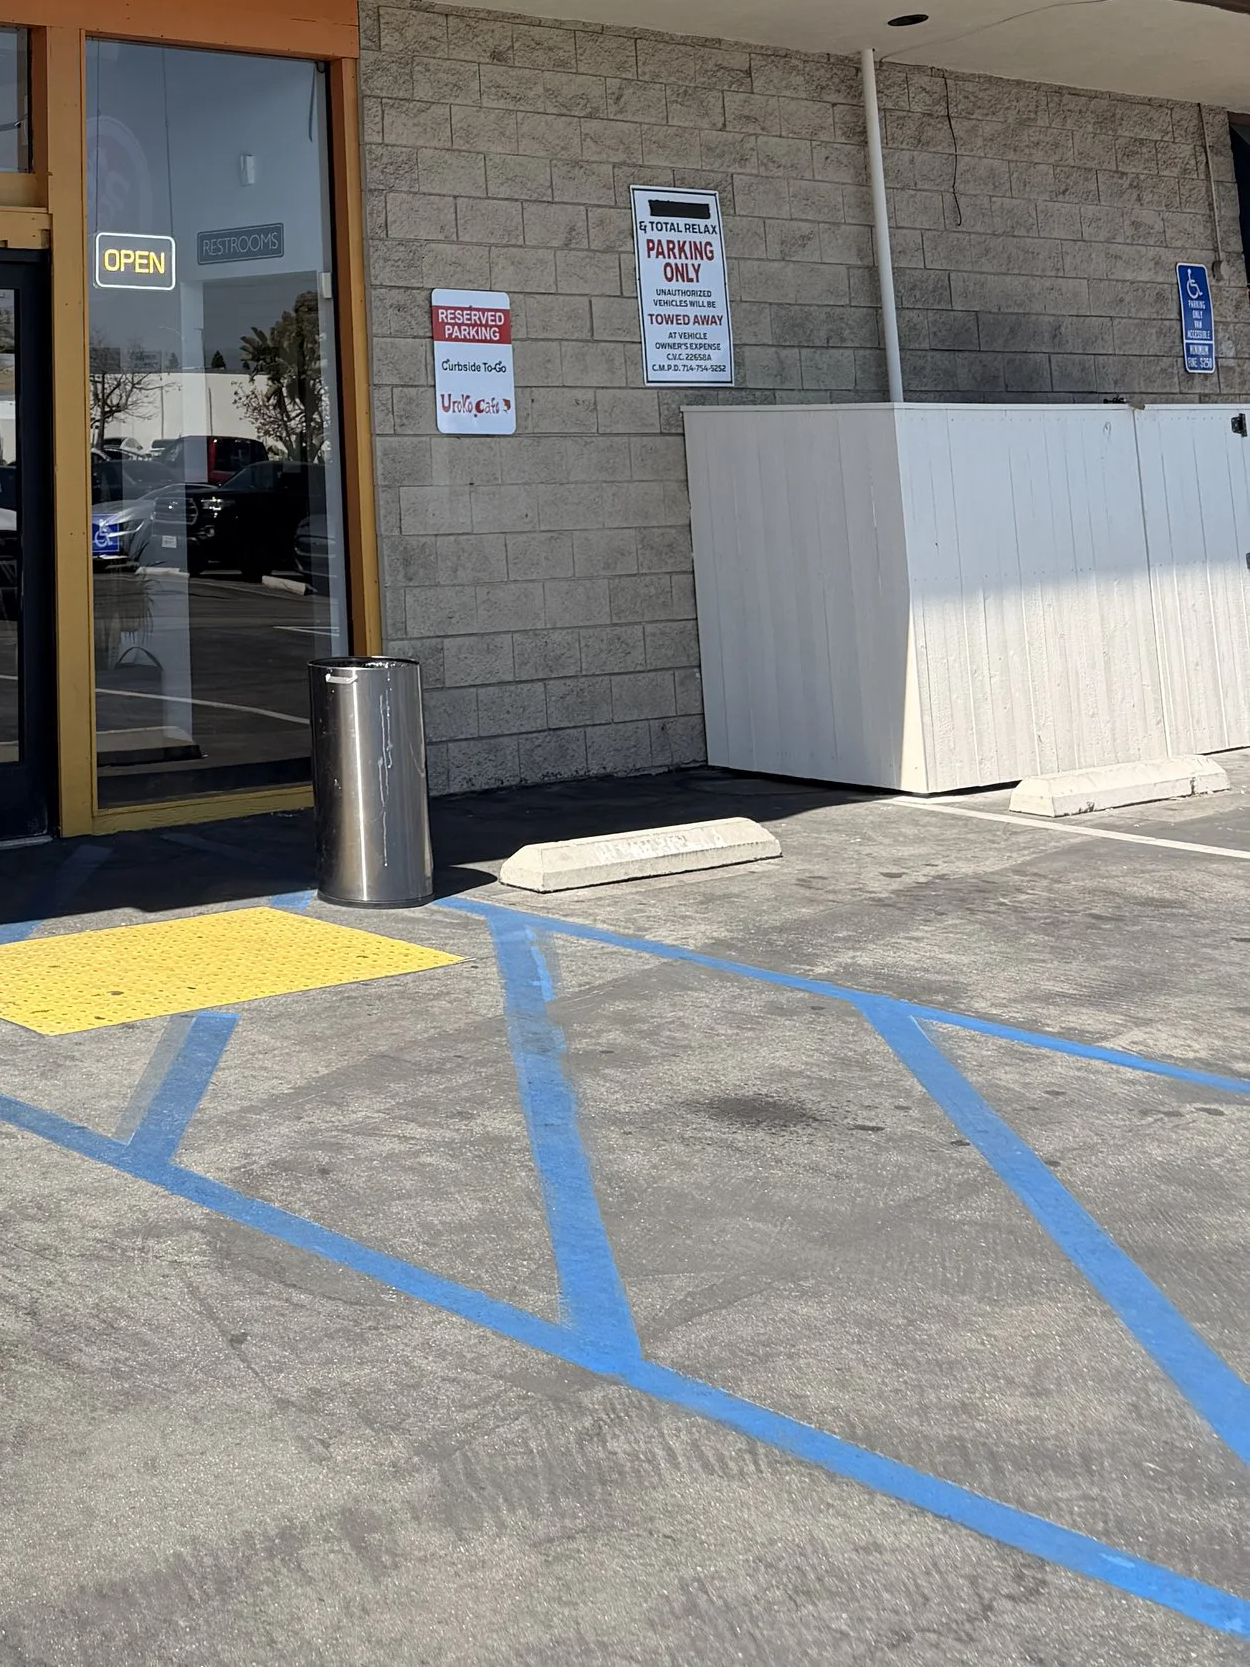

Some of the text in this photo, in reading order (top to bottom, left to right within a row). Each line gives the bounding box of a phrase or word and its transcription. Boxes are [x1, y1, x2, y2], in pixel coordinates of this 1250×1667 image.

[639, 220, 718, 235] & TOTAL RELAX
[202, 231, 279, 257] RESTROOMS
[646, 238, 715, 261] PARKING
[104, 248, 166, 274] OPEN
[663, 262, 701, 283] ONLY
[655, 288, 712, 298] UNAUTHORIZED
[653, 299, 717, 309] VEHICLES WILL BE
[438, 308, 505, 325] RESERVED
[647, 313, 724, 326] TOWED AWAY
[444, 325, 500, 341] PARKING
[668, 332, 708, 340] AT VEHICLE
[655, 342, 721, 351] OWNER'S EXPENSE
[685, 353, 712, 361] 22658A
[441, 359, 507, 373] Curbside To-Go
[681, 364, 727, 373] 714-754-5252
